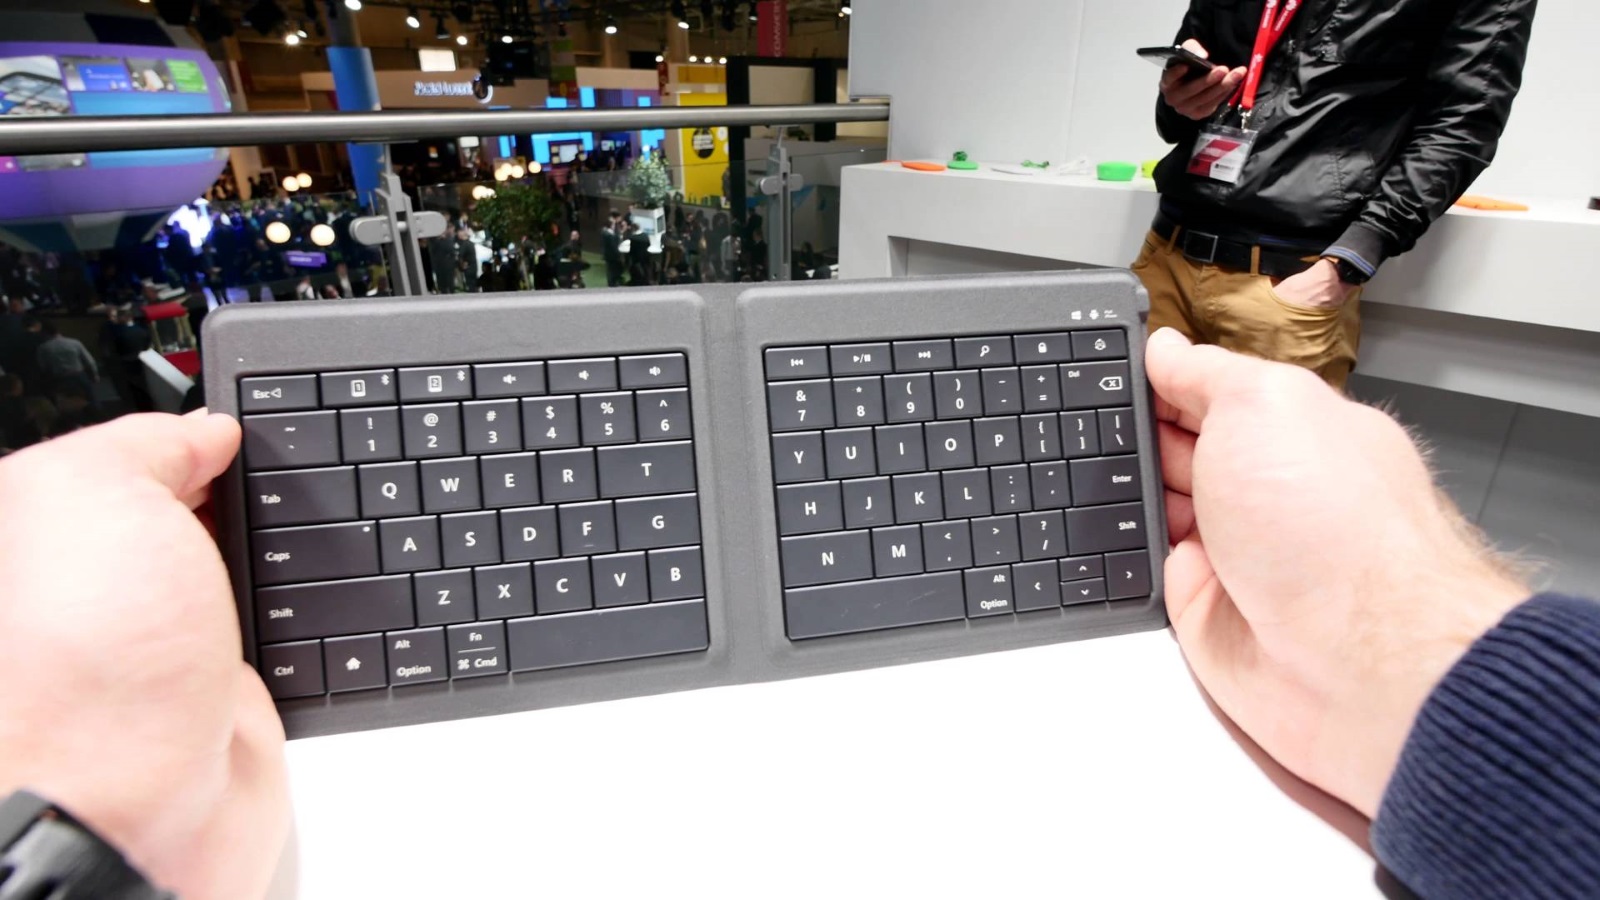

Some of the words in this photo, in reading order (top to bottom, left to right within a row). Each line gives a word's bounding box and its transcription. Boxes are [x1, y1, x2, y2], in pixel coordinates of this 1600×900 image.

[1067, 370, 1081, 378] Del
[252, 389, 271, 400] Esc
[795, 389, 807, 402] &
[600, 401, 615, 415] %
[856, 404, 866, 417] 8
[906, 401, 916, 414] 9
[955, 397, 965, 410] 0
[423, 412, 439, 427] @
[486, 410, 497, 422] #
[545, 405, 555, 420] $
[797, 409, 807, 422] 7
[367, 417, 374, 430] !
[604, 422, 614, 436] 5
[660, 418, 670, 432] 6
[488, 430, 498, 444] 3
[546, 426, 557, 439] 4
[367, 439, 376, 452] 1
[427, 434, 438, 448] 2
[944, 437, 957, 452] O
[994, 433, 1004, 447] P
[793, 450, 804, 465] Y
[845, 445, 857, 460] U
[562, 468, 574, 483] R
[640, 462, 652, 477] T
[440, 477, 460, 493] W
[504, 473, 516, 488] E
[1111, 475, 1132, 484] Enter
[381, 482, 398, 500] Q
[914, 491, 925, 505] K
[963, 487, 973, 501] L
[260, 493, 282, 504] Tab
[865, 496, 873, 511] J
[804, 501, 817, 516] H
[582, 521, 592, 536] F
[651, 514, 665, 530] G
[1040, 520, 1047, 531] ?
[1118, 520, 1137, 531] Shift
[464, 531, 476, 547] S
[522, 526, 537, 542] D
[402, 536, 418, 552] A
[891, 543, 907, 559] M
[264, 551, 291, 563] Caps
[821, 551, 834, 566] N
[613, 572, 627, 587] V
[670, 566, 682, 582] B
[992, 574, 1006, 583] Alt
[497, 583, 512, 599] X
[556, 577, 569, 594] C
[437, 589, 451, 606] Z
[979, 598, 1008, 611] Option
[269, 607, 294, 619] Shift
[469, 632, 483, 642] Fn
[394, 639, 411, 650] Alt
[473, 656, 498, 668] Cmd
[274, 665, 295, 676] Ctrl
[395, 665, 432, 678] Option
